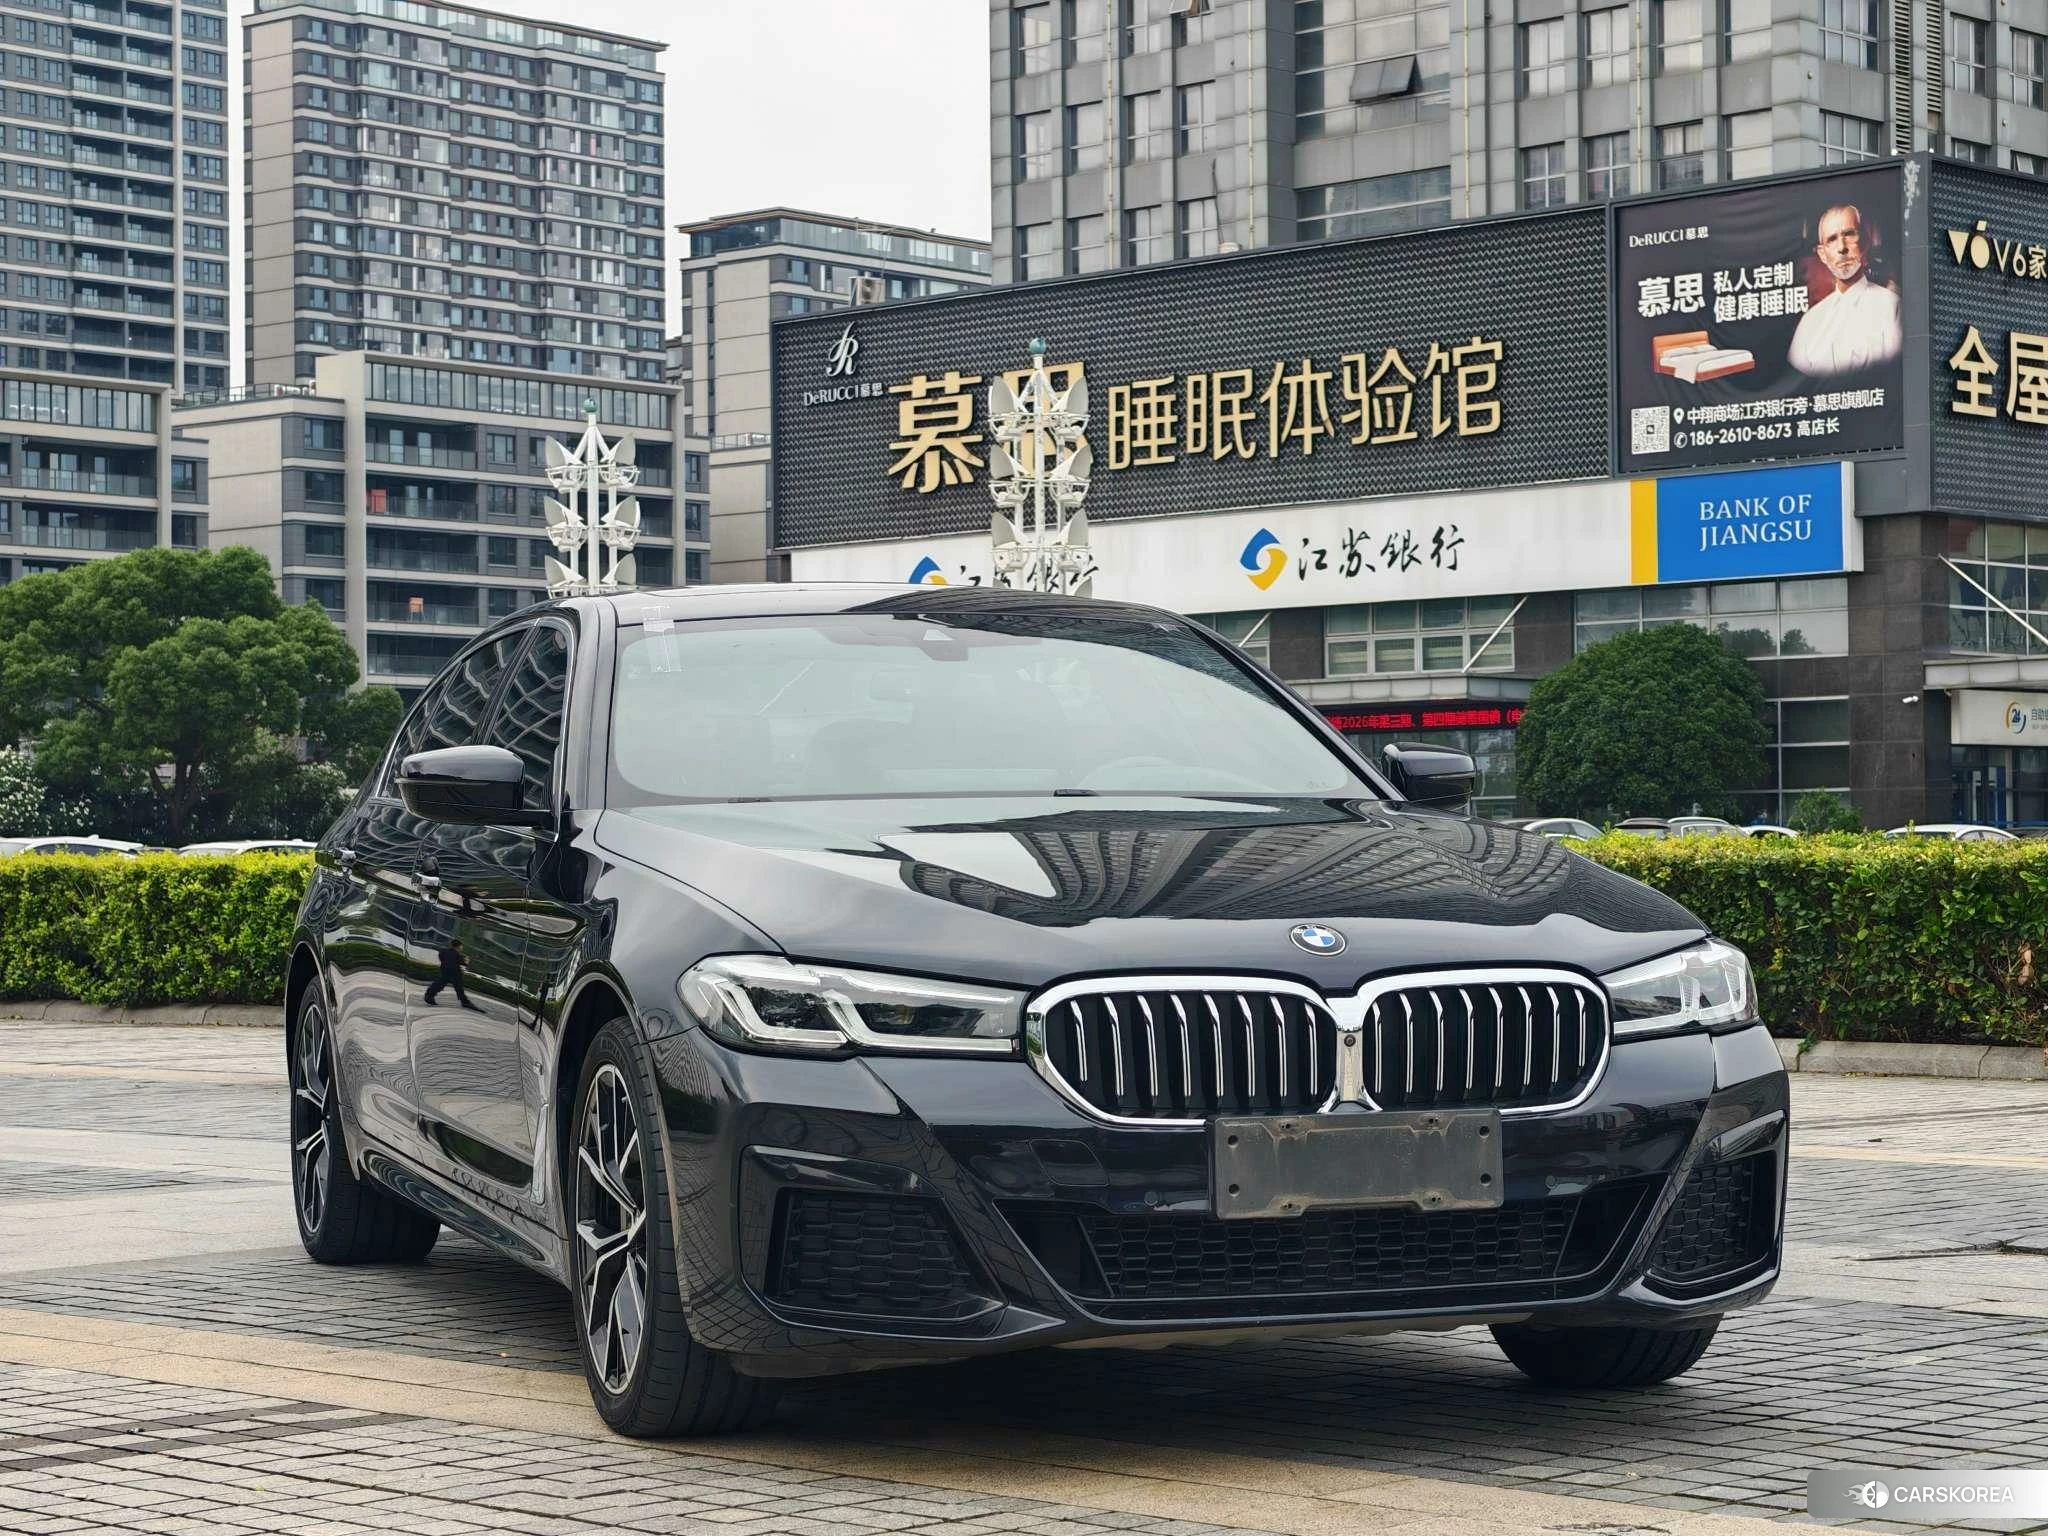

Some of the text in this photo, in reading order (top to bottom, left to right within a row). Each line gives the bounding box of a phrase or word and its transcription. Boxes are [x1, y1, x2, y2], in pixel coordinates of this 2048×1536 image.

[1629, 229, 1684, 248] DeRUCCI
[1713, 261, 1794, 294] 私人定制
[1638, 273, 1706, 317] 慕思
[1714, 286, 1809, 323] 健康睡眠
[803, 385, 859, 406] DeRUCCI
[1690, 417, 1840, 446] 186-2610-8673 高店长
[1700, 494, 1812, 521] BANK OF
[1700, 519, 1812, 551] JIANGSU
